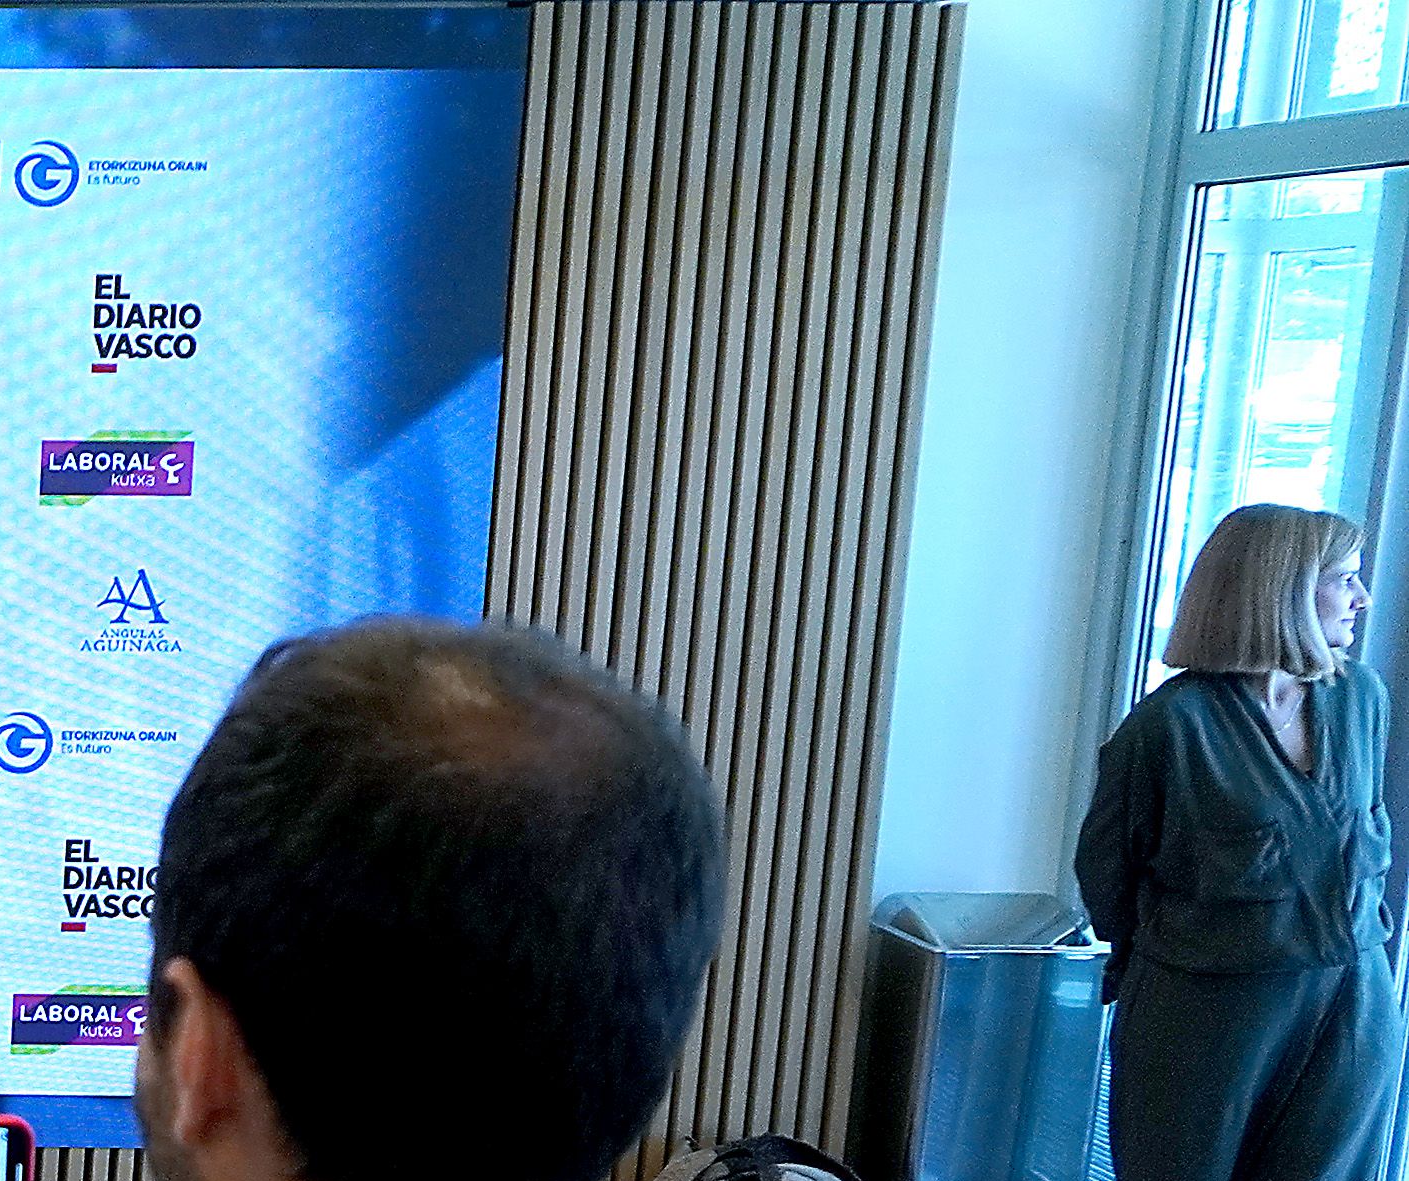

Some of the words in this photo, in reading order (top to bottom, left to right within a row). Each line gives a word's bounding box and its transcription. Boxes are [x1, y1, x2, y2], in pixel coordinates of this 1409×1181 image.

[89, 161, 165, 171] ETORKIZUNA
[168, 161, 207, 171] ORAIN
[103, 174, 140, 185] futuro
[95, 274, 130, 299] EL
[94, 304, 201, 329] DIARIO
[94, 333, 196, 359] VASCO
[49, 453, 155, 471] LABORAL
[112, 474, 155, 486] kutxa
[101, 629, 163, 638] ANGULAS
[81, 640, 181, 652] AGUINAGA
[62, 731, 135, 740] ETORKIZUNA
[139, 731, 176, 741] ORAIN
[76, 744, 111, 754] futuro
[65, 840, 99, 862] EL
[20, 1005, 122, 1022] LABORAL
[80, 1020, 122, 1037] kutxa
